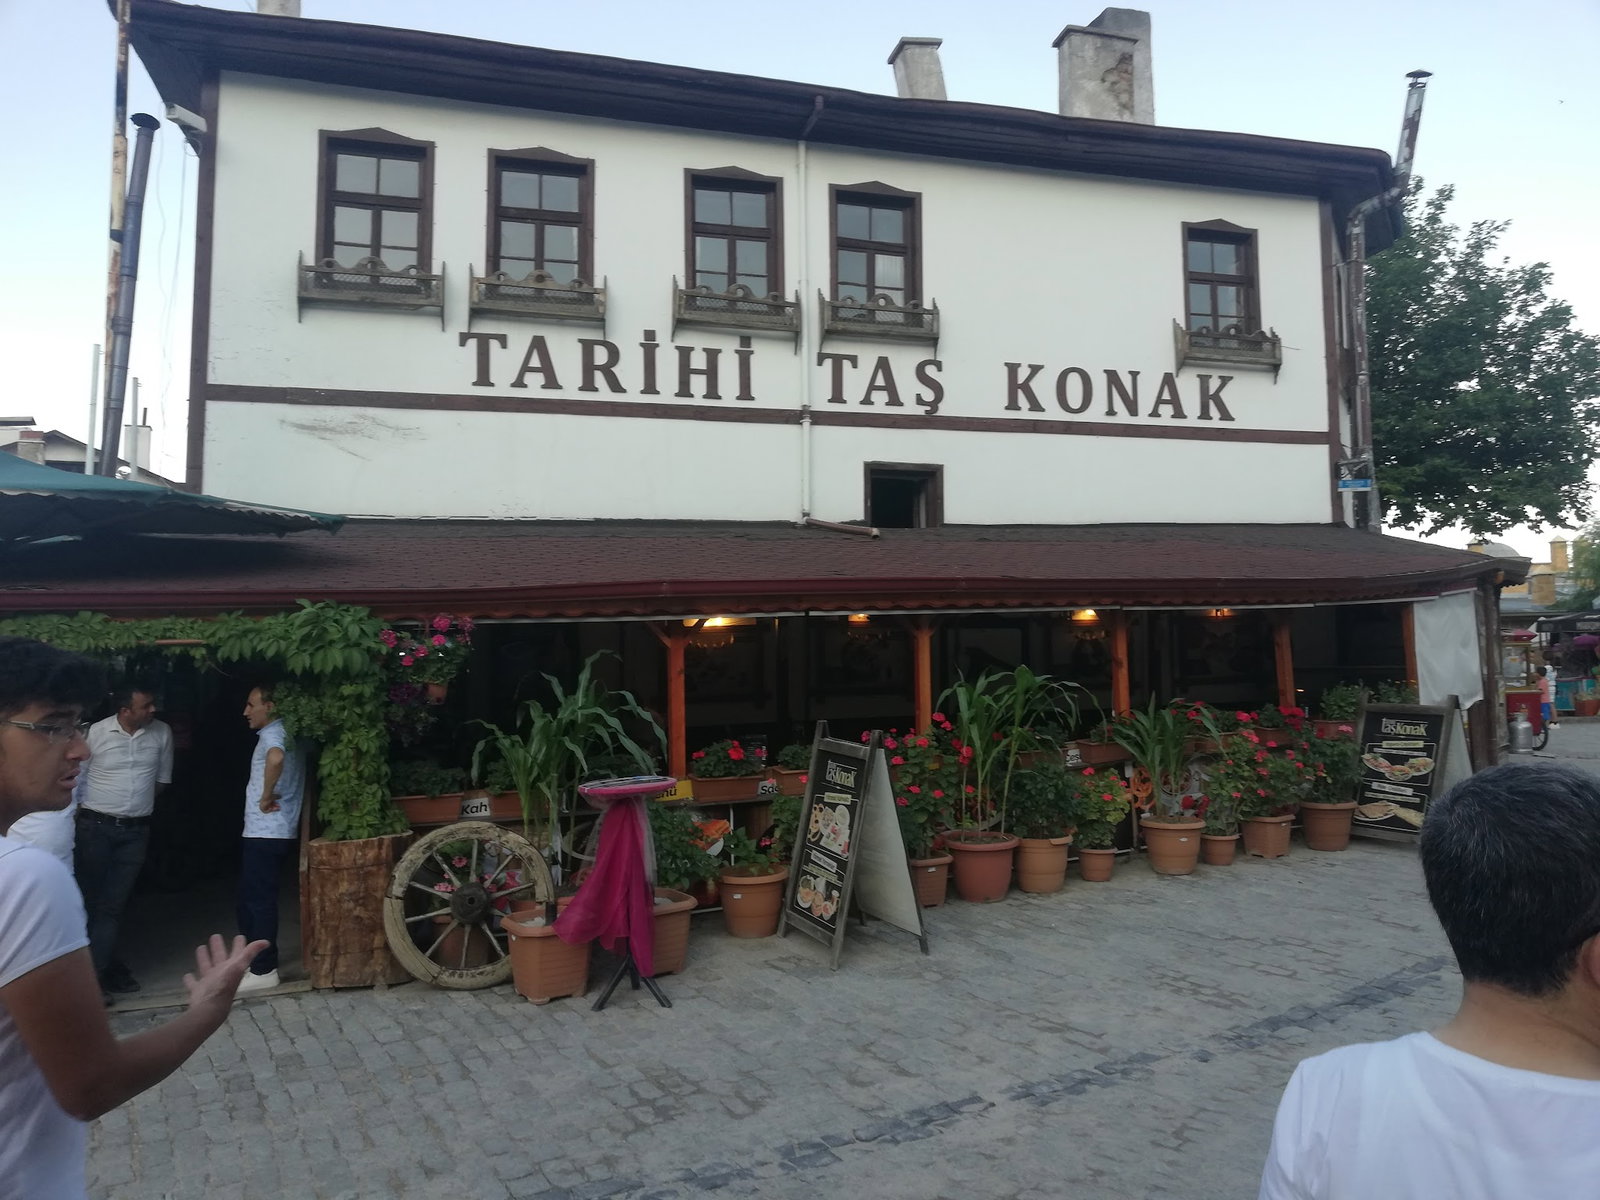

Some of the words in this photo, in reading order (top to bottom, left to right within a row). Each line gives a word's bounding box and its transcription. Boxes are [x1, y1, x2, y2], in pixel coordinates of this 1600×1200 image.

[459, 329, 756, 401] TARİHİ
[816, 351, 945, 415] TAŞ
[1003, 361, 1236, 422] KONAK
